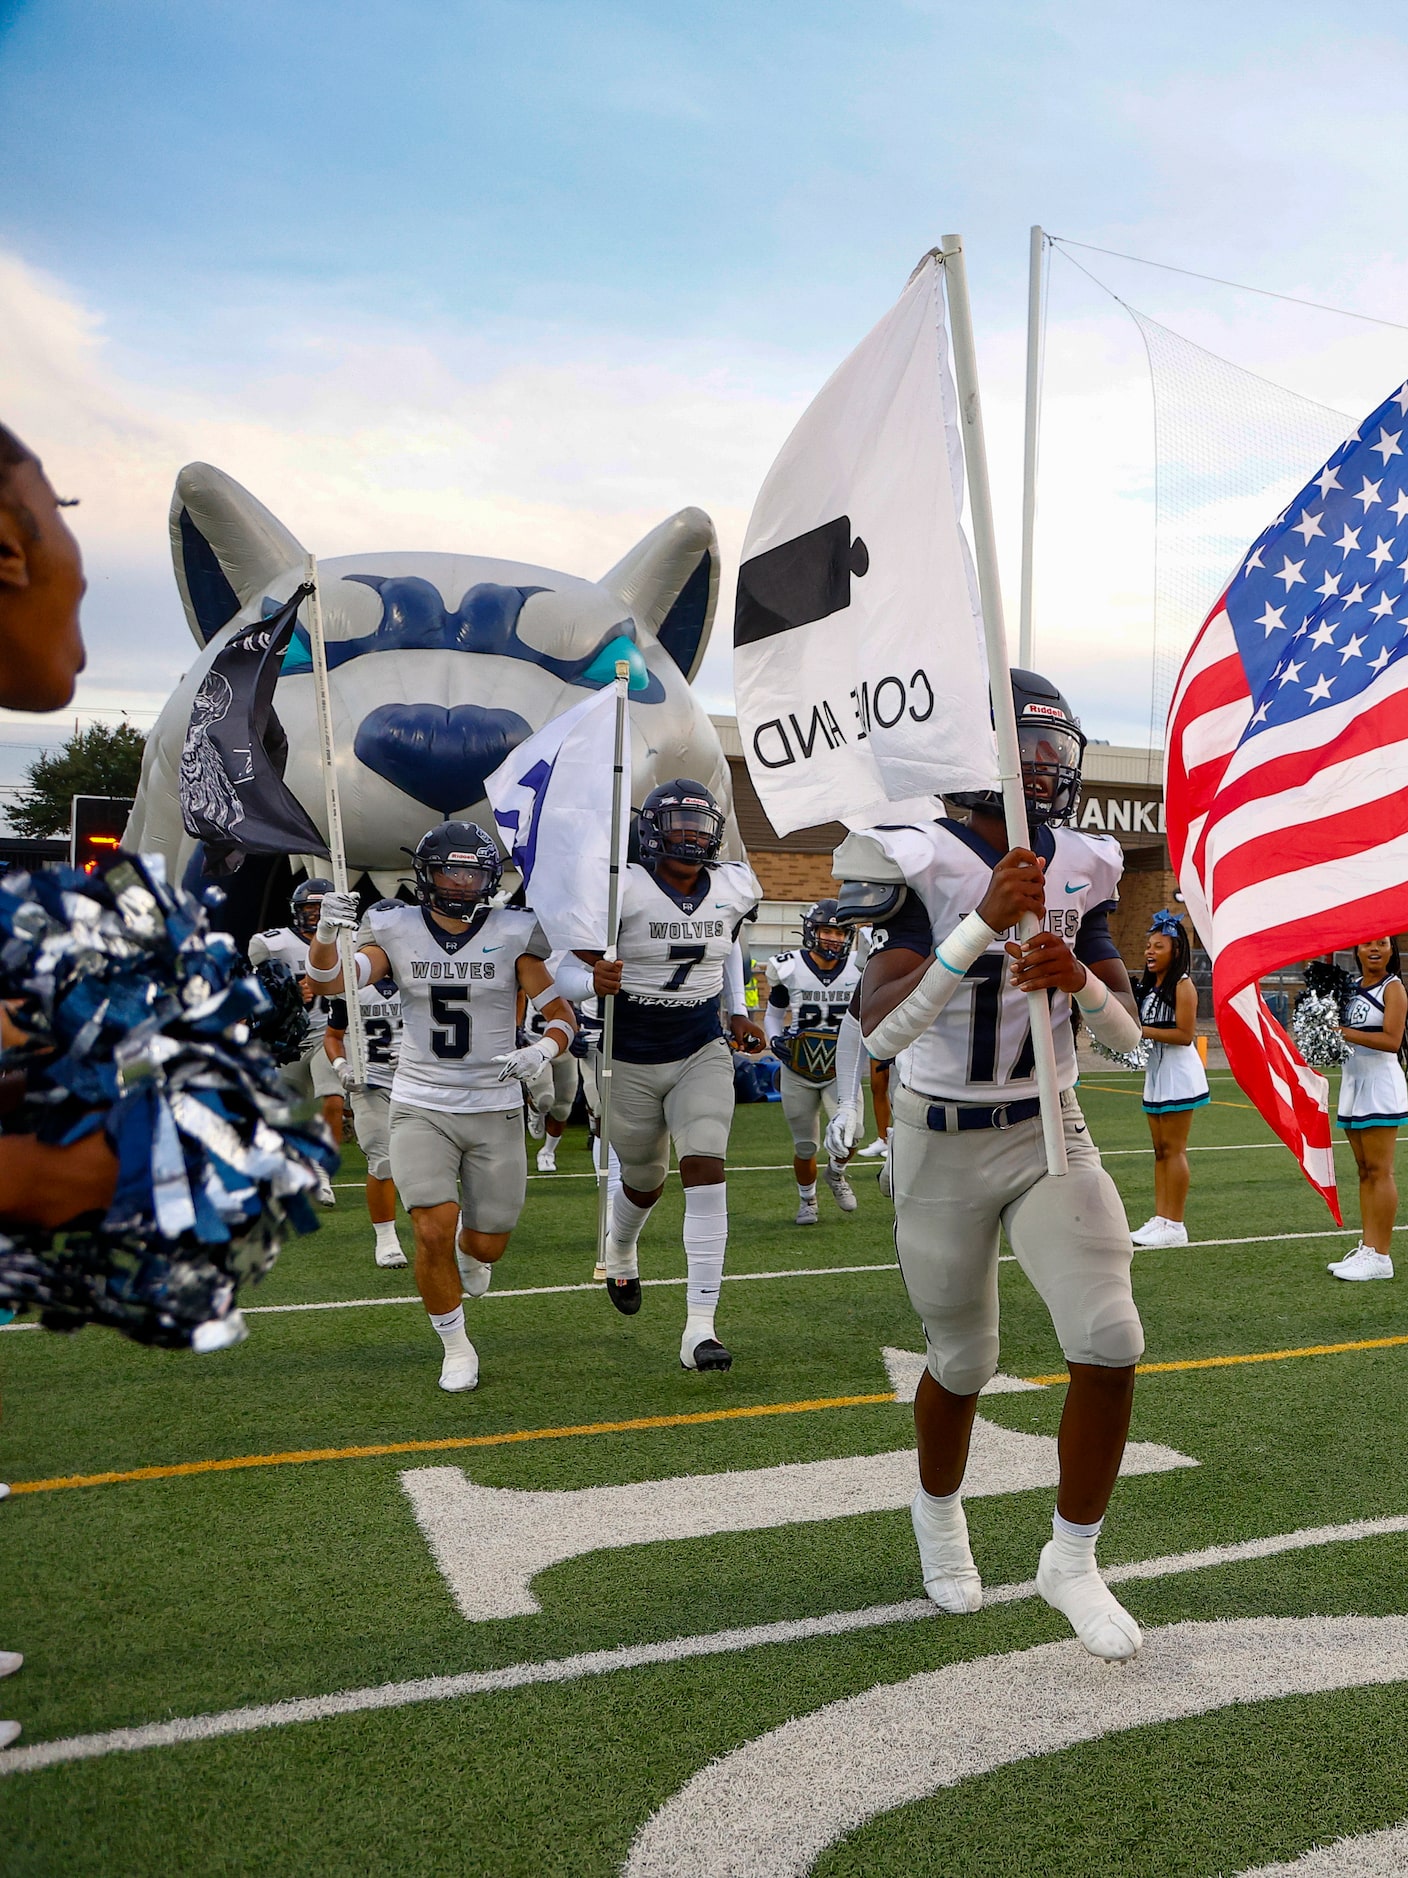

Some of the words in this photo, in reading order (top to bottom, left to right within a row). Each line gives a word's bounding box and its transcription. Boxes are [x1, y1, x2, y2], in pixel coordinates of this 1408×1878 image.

[1029, 705, 1063, 717] Riddell
[1069, 797, 1167, 833] ANK
[649, 920, 724, 940] WOLVES
[411, 961, 495, 980] WOLVES
[659, 942, 709, 992] 7
[800, 990, 851, 1002] WOLVES
[428, 984, 473, 1062] 5
